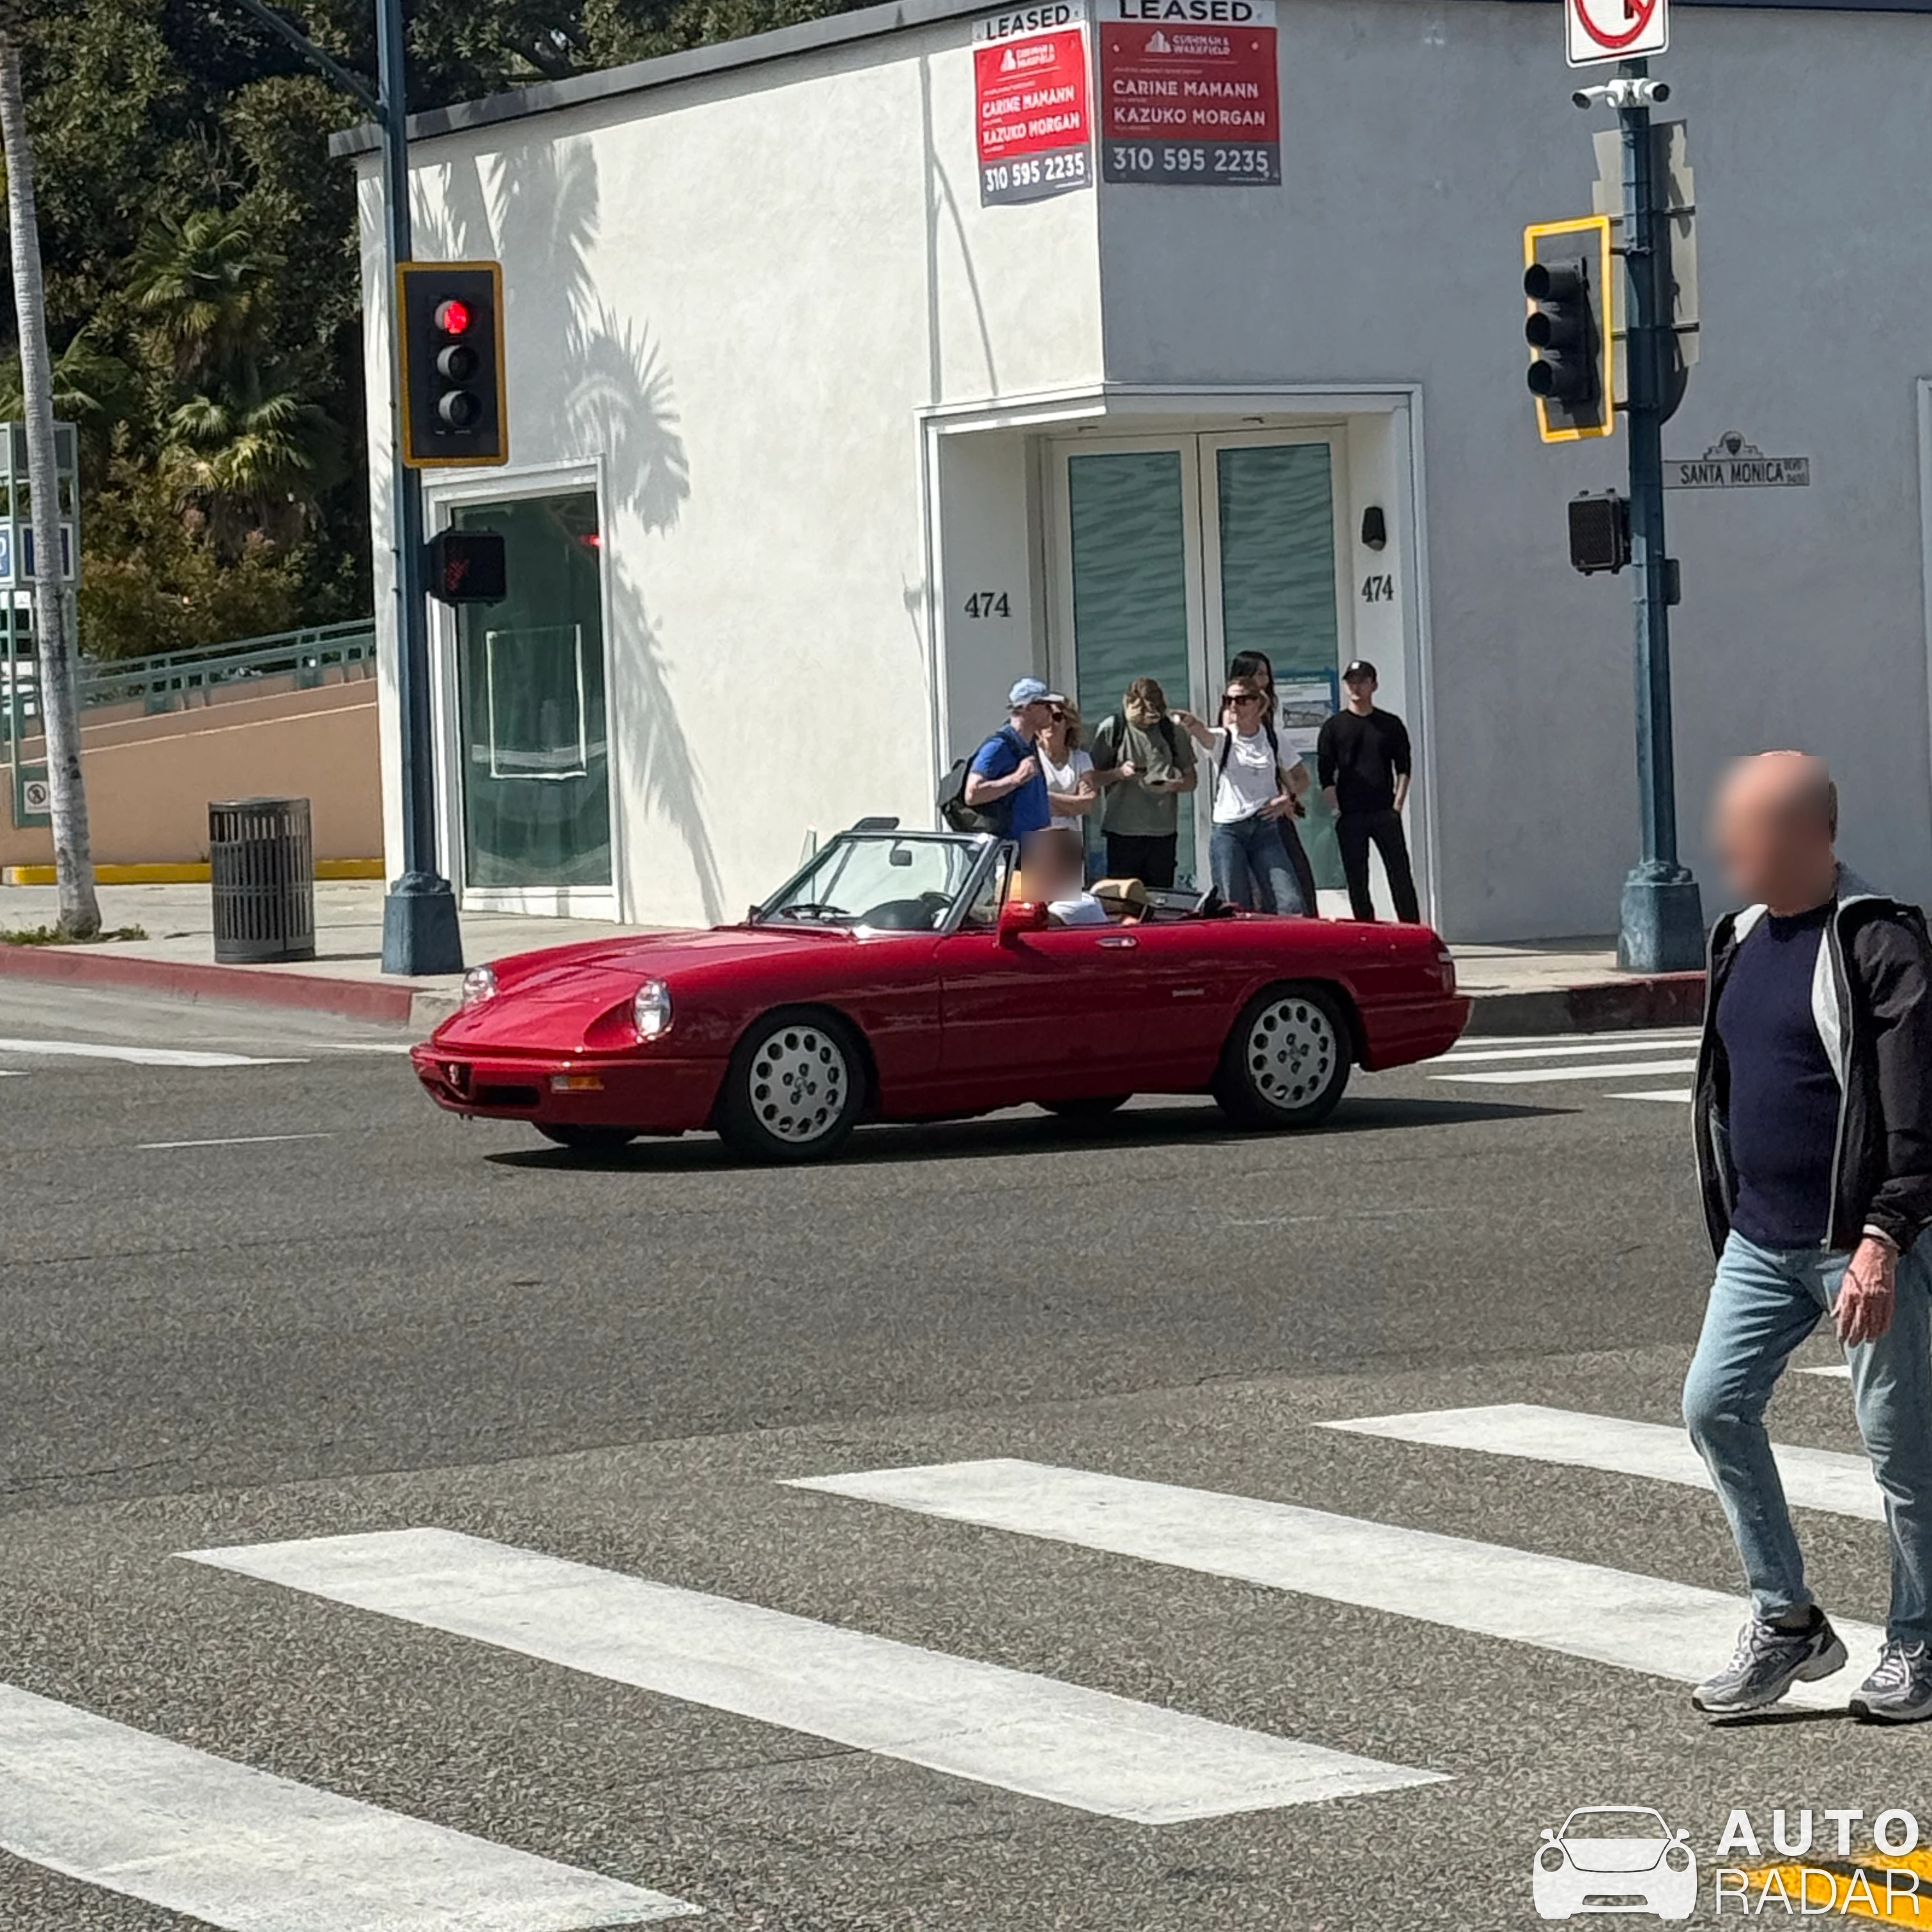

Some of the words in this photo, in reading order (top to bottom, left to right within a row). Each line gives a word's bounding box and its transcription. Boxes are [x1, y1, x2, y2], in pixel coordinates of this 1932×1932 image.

[986, 5, 1070, 40] LEASED
[1120, 0, 1252, 21] LEASED
[983, 96, 1021, 118] CARINE
[1023, 85, 1075, 109] MAMANN
[1113, 80, 1178, 95] CARINE
[1184, 82, 1258, 98] MAMANN
[1029, 112, 1080, 137] MORGAN
[1114, 107, 1186, 123] KAZUKO
[1192, 109, 1265, 126] MORGAN
[985, 166, 1008, 192] 310
[1012, 160, 1040, 187] 595
[1045, 152, 1085, 181] 2235
[1113, 147, 1154, 171] 310
[1163, 148, 1206, 171] 595
[1214, 150, 1268, 172] 2235
[1680, 464, 1725, 485] SANTA
[1730, 463, 1783, 483] MONICA
[1361, 574, 1393, 602] 474
[965, 592, 1011, 618] 474
